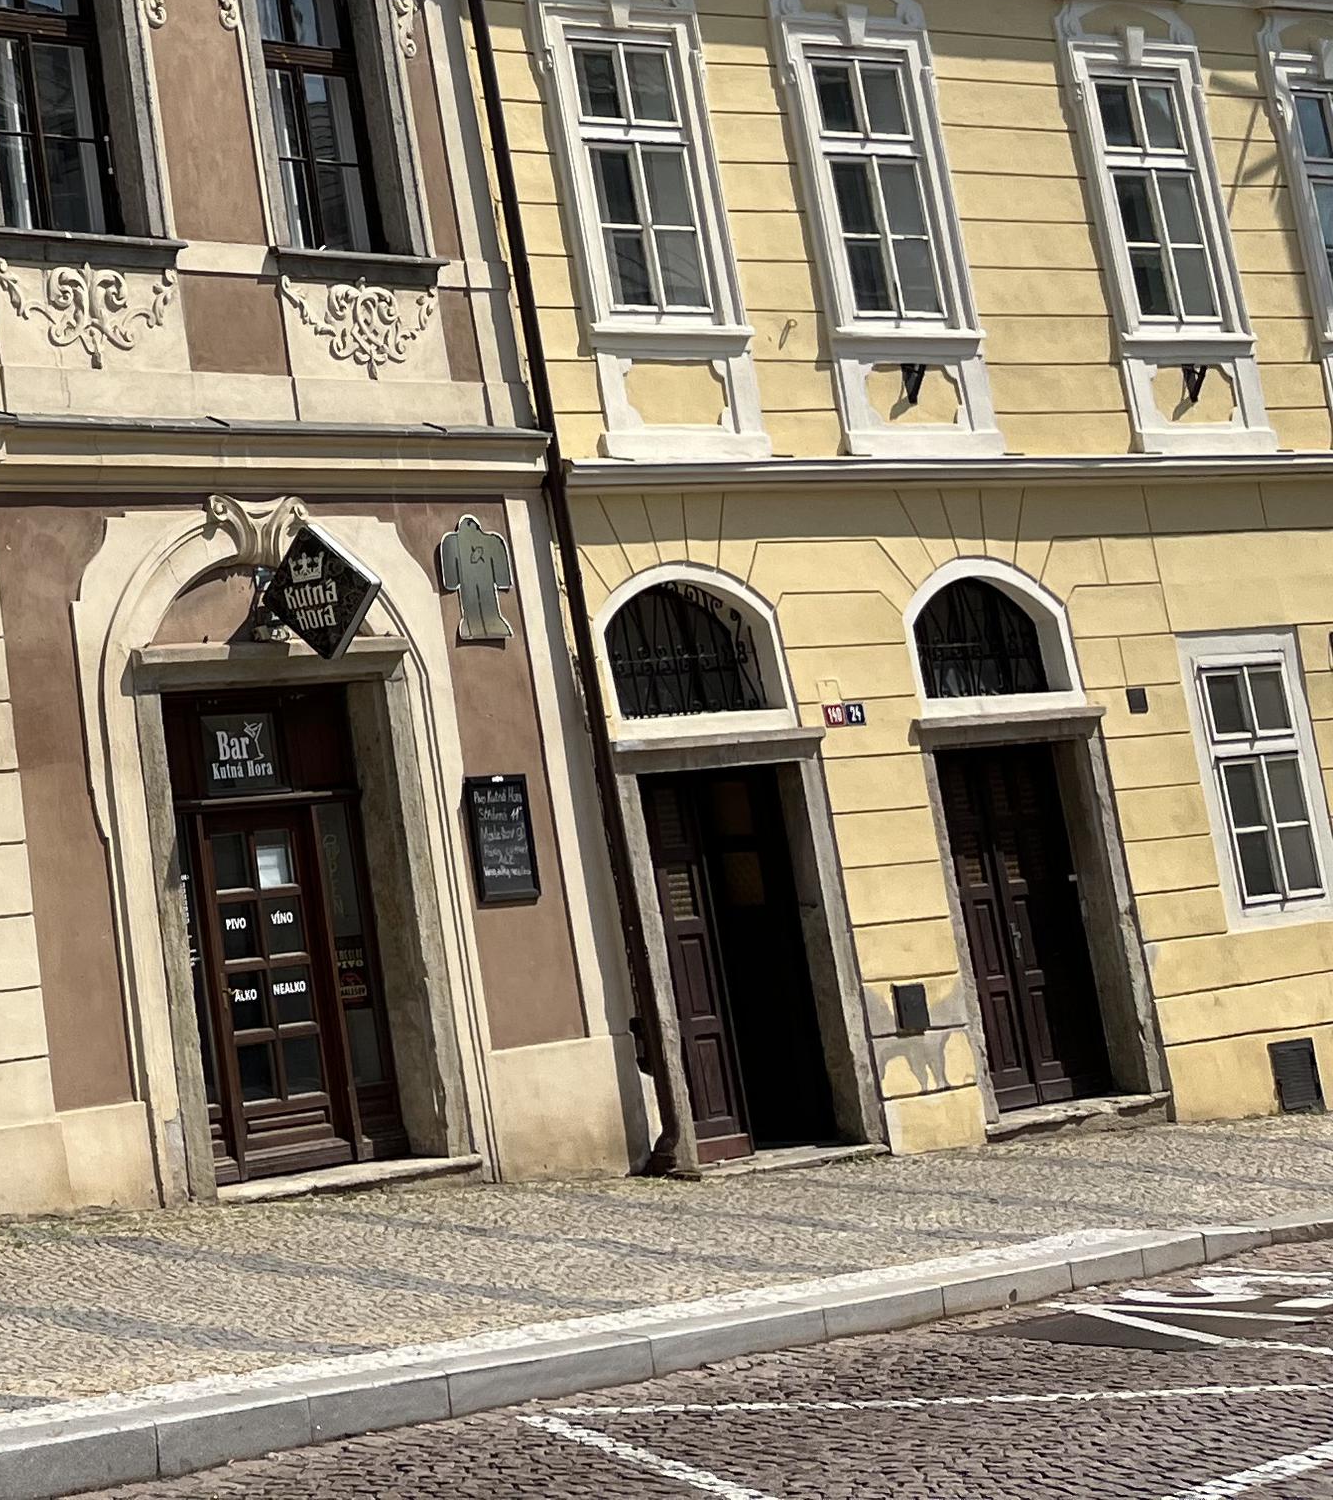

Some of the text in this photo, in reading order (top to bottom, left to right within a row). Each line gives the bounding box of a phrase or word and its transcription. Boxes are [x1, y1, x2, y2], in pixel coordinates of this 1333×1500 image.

[284, 578, 338, 610] Kutná
[296, 604, 337, 631] Hora
[849, 705, 861, 722] 24
[215, 730, 249, 760] Bar
[211, 760, 273, 780] Kutná Hora
[225, 917, 247, 930] PIVO
[270, 910, 293, 925] VÍNO
[234, 988, 257, 1002] ALKO
[273, 980, 306, 995] NEALKO
